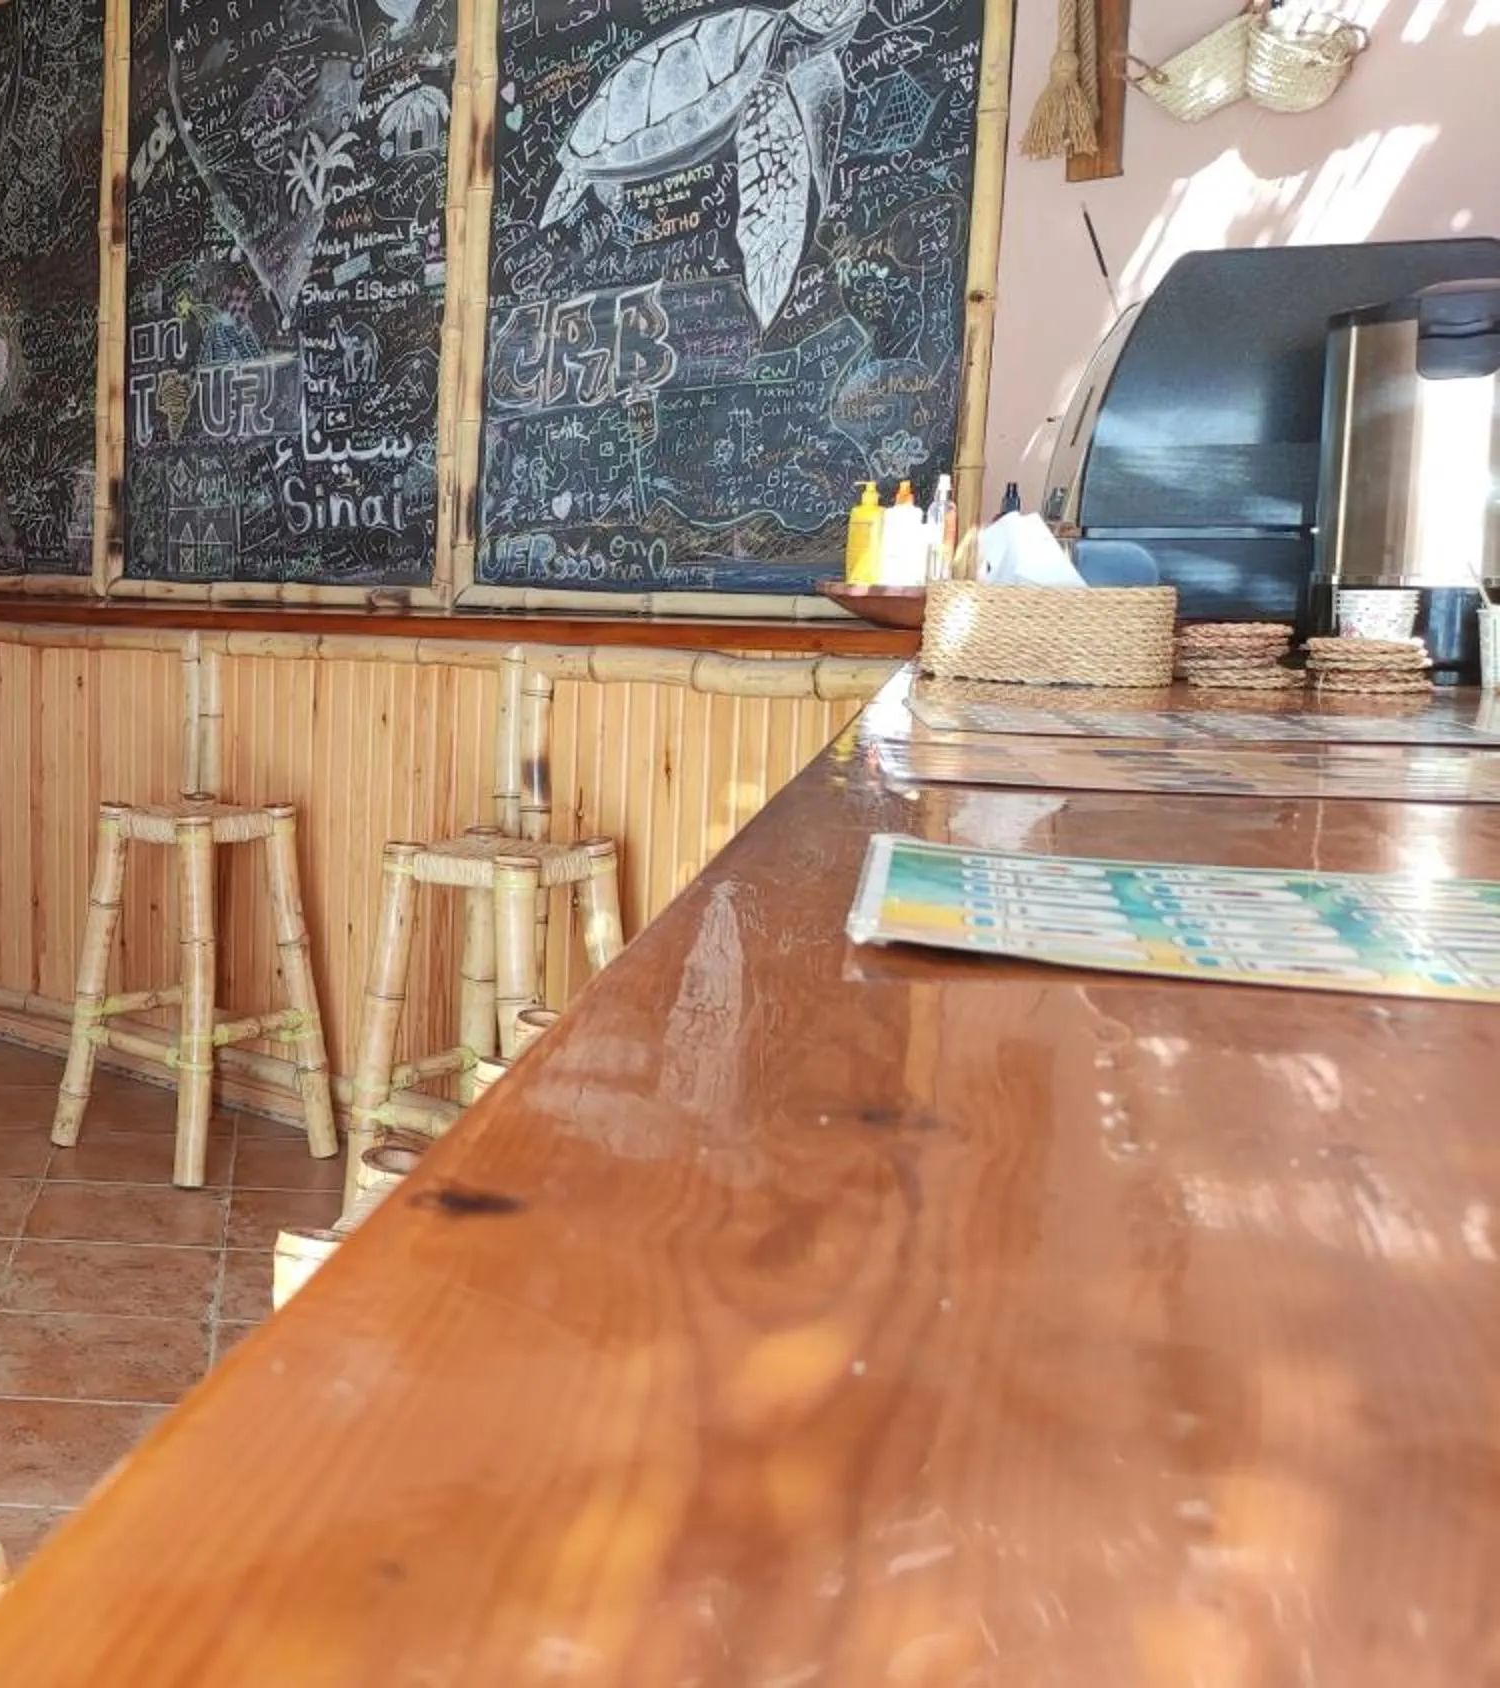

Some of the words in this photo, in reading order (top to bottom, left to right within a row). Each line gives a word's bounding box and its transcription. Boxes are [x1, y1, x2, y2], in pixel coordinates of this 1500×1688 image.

[367, 47, 405, 71] Taba
[332, 172, 376, 204] Dahab
[409, 217, 440, 243] Park
[301, 282, 350, 305] Sharm
[273, 393, 413, 475] سيناء
[284, 474, 407, 534] Sinai
